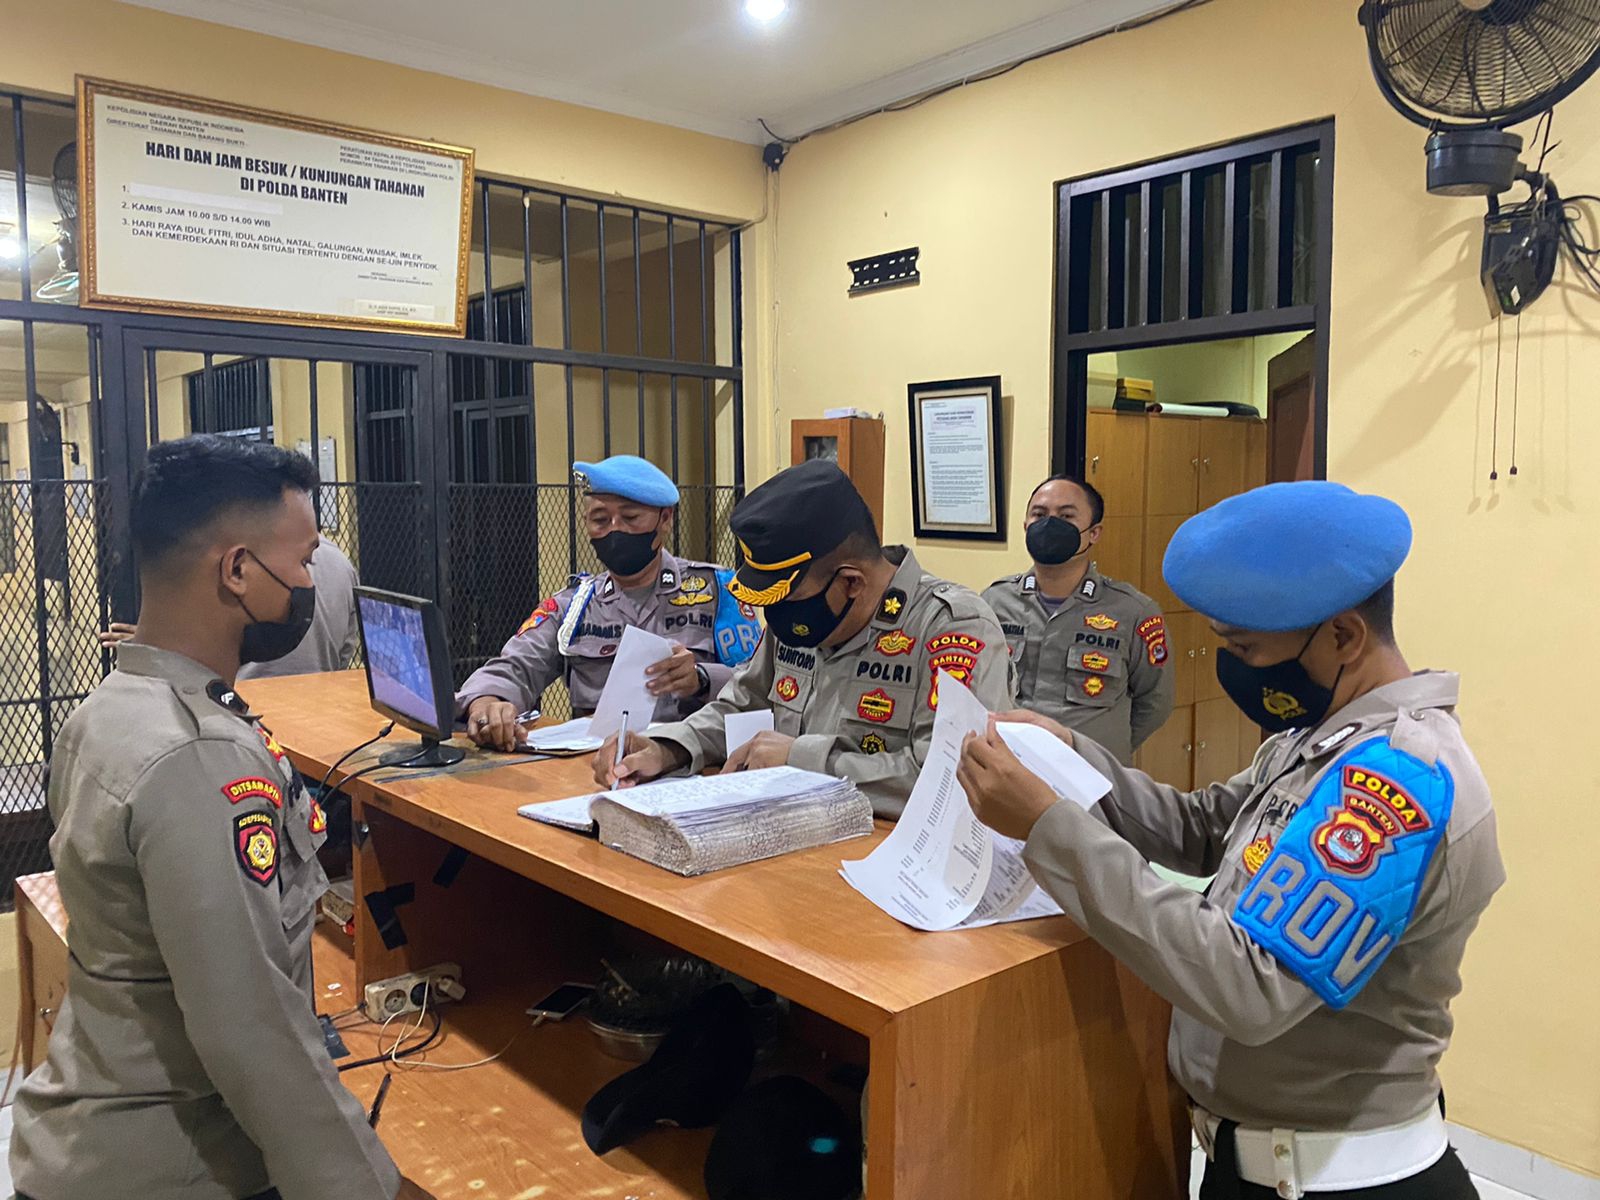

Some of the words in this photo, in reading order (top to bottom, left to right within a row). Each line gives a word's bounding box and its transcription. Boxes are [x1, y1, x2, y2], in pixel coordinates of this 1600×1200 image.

[106, 104, 148, 117] KEPOLISIAN
[148, 112, 177, 122] NEGARA
[177, 116, 209, 128] REPUBLIK
[210, 122, 244, 133] INDONESIA
[106, 117, 149, 130] DIREKTORAT
[149, 119, 178, 129] DAERAH
[178, 123, 205, 133] BANTEN
[146, 141, 180, 160] HARI
[183, 147, 212, 165] DAN
[215, 153, 242, 170] JAM
[245, 157, 288, 177] BESUK
[300, 165, 371, 190] KUNJUNGAN
[373, 178, 425, 198] TAHANAN
[240, 177, 254, 192] DI
[258, 180, 298, 198] POLDA
[301, 187, 348, 205] BANTEN
[131, 202, 163, 214] KAMIS
[165, 206, 185, 217] JAM
[188, 210, 211, 220] 10.00
[212, 213, 228, 223] S/D
[231, 215, 252, 226] 14.00
[254, 218, 271, 228] WIB
[132, 219, 156, 229] HARI
[158, 222, 182, 233] RAYA
[184, 226, 206, 236] IDUL
[208, 228, 233, 240] FITRI,
[235, 232, 256, 242] IDUL
[258, 235, 283, 246] ADHA,
[286, 237, 315, 249] NATAL,
[317, 241, 364, 255] GALUNGAN,
[366, 247, 398, 259] WAISAK,
[399, 252, 423, 261] IMLEK
[132, 228, 153, 238] DAN
[155, 230, 228, 247] KEMERDEKAAN
[229, 240, 239, 249] RI
[241, 241, 260, 250] DAN
[262, 244, 295, 255] SITUASI
[298, 247, 340, 260] TERTENTU
[341, 253, 375, 264] DENGAN
[665, 614, 713, 631] POLRI
[931, 634, 978, 650] POLDA
[1075, 633, 1120, 650] POLRI
[857, 660, 913, 683] POLRI
[933, 655, 971, 667] BANTEN
[1351, 771, 1420, 824] POLDA
[1349, 797, 1395, 832] BANTEN
